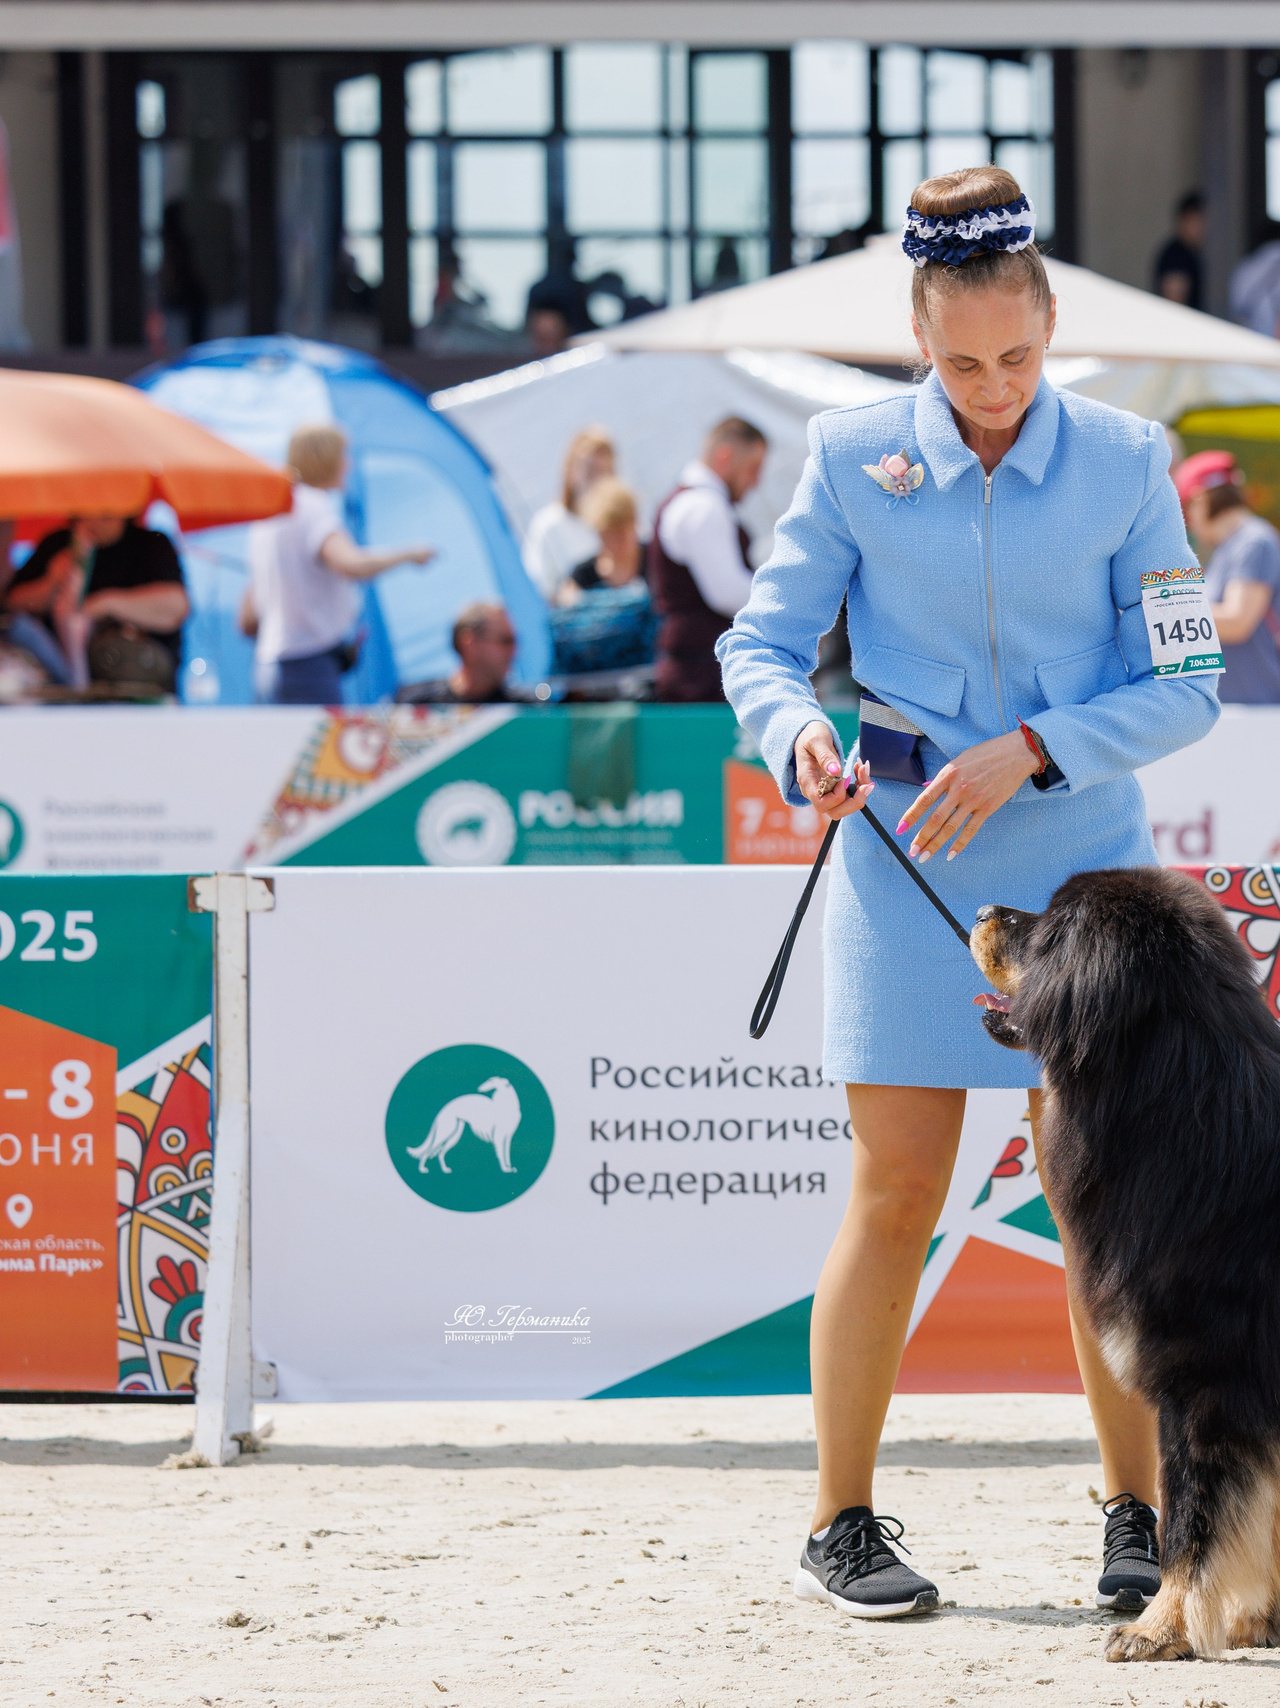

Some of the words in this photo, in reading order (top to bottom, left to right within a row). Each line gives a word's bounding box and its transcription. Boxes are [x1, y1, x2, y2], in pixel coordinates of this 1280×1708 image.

[1153, 617, 1212, 646] 1450
[1189, 657, 1220, 668] 7.06.2025
[590, 1161, 826, 1206] федерация
